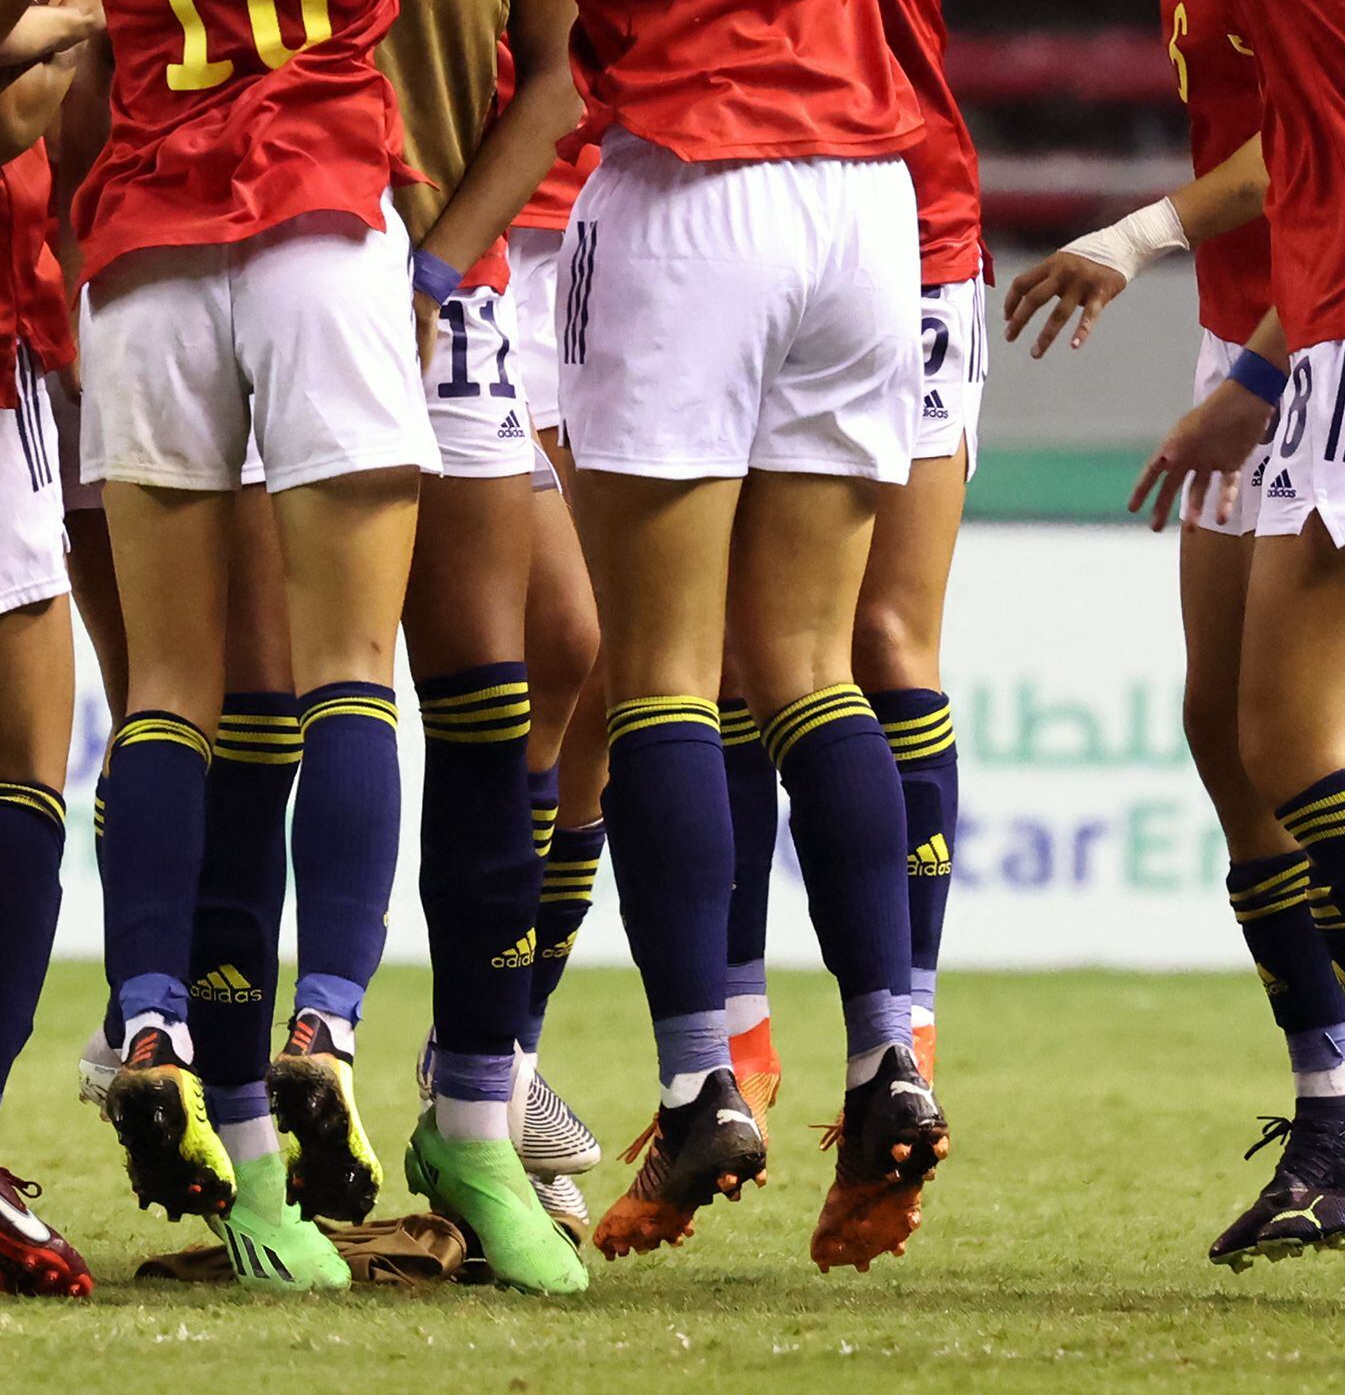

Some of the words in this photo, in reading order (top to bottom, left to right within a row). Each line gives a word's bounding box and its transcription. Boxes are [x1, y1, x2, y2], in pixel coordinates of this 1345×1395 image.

[438, 299, 517, 399] 11
[1280, 355, 1312, 459] 8
[497, 427, 525, 439] adidas
[1267, 487, 1297, 498] adidas
[190, 983, 263, 1004] adidas
